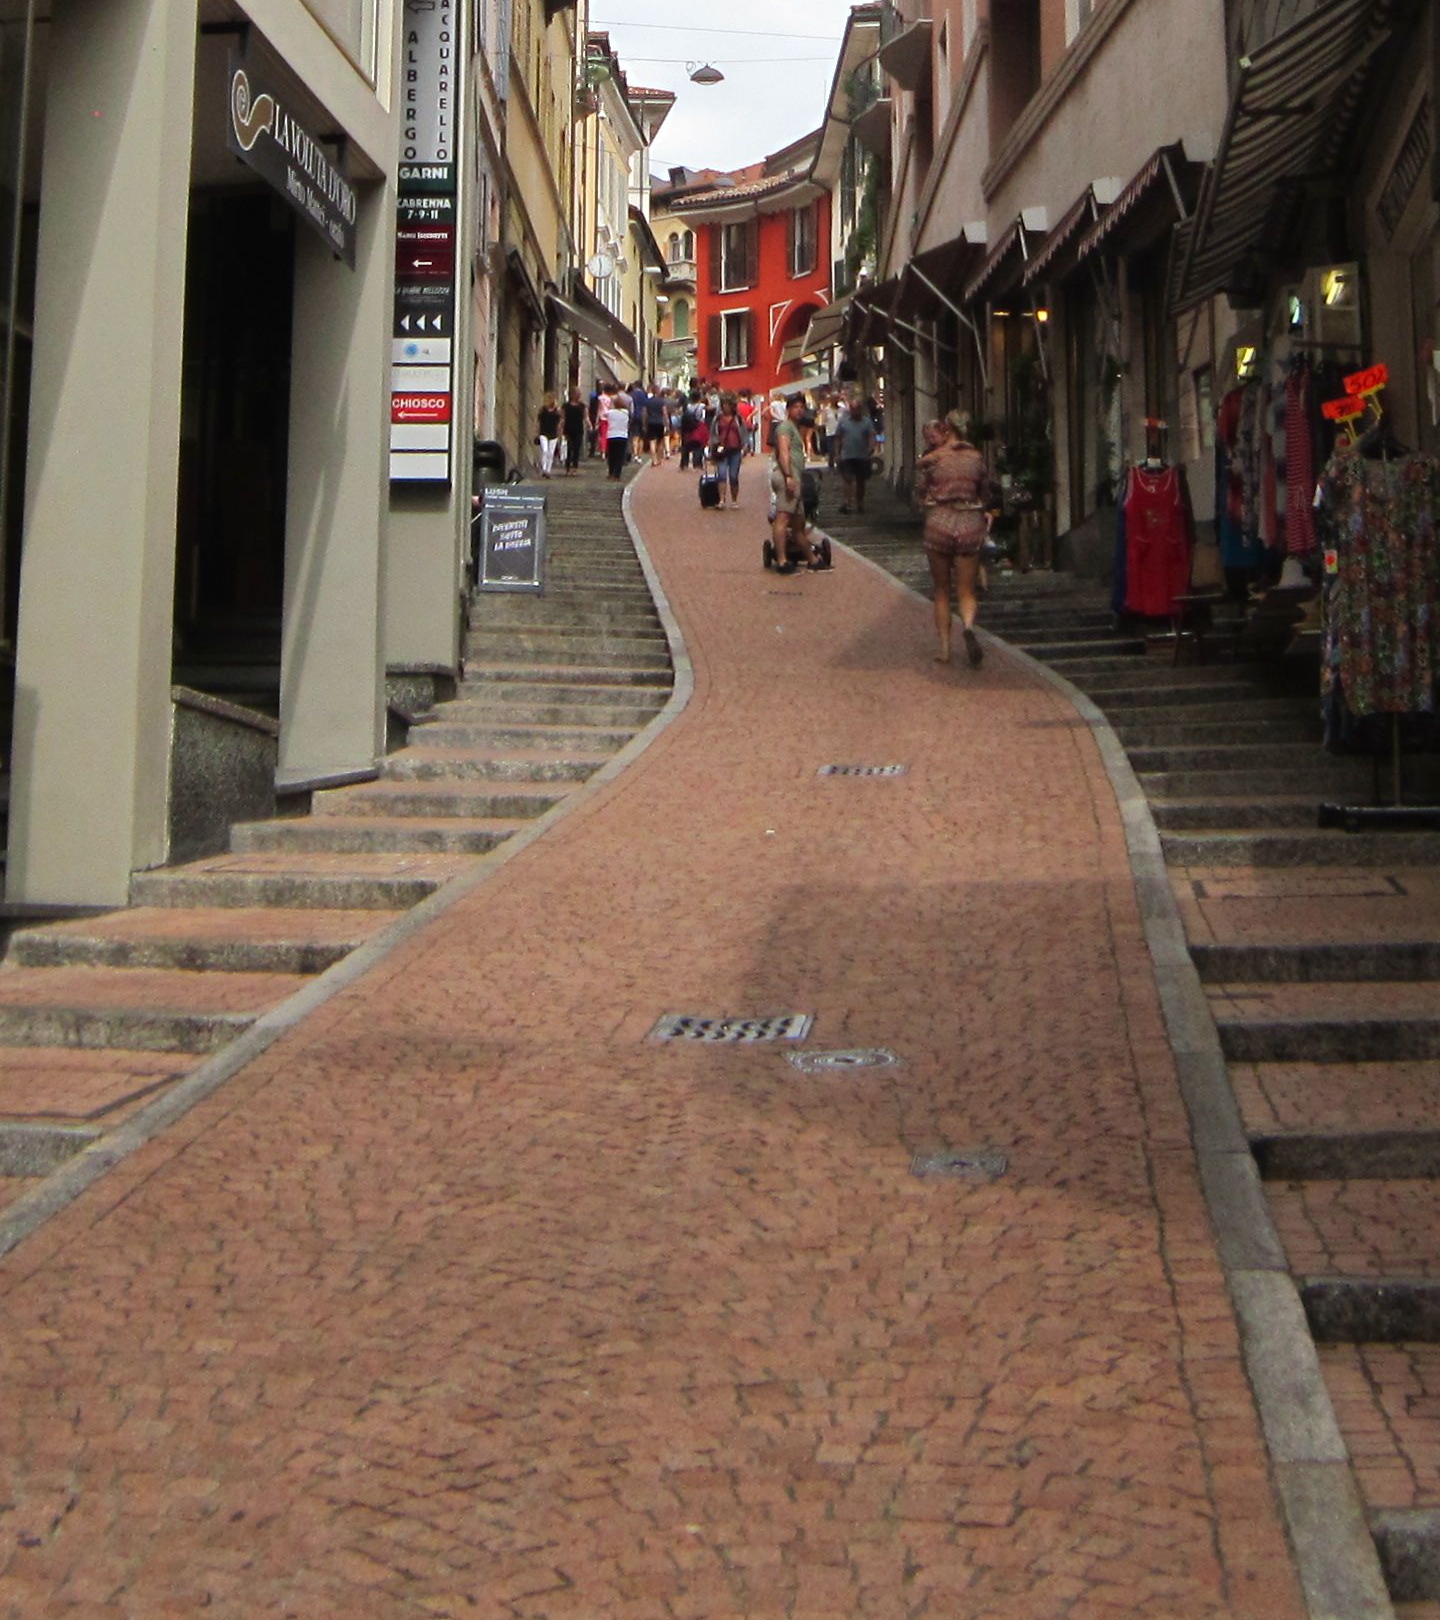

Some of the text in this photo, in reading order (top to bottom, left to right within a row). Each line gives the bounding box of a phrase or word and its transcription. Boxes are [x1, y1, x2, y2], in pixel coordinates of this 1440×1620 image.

[404, 31, 418, 160] ALBERGO
[400, 167, 448, 179] GARNI
[392, 398, 445, 409] CHIOSCO
